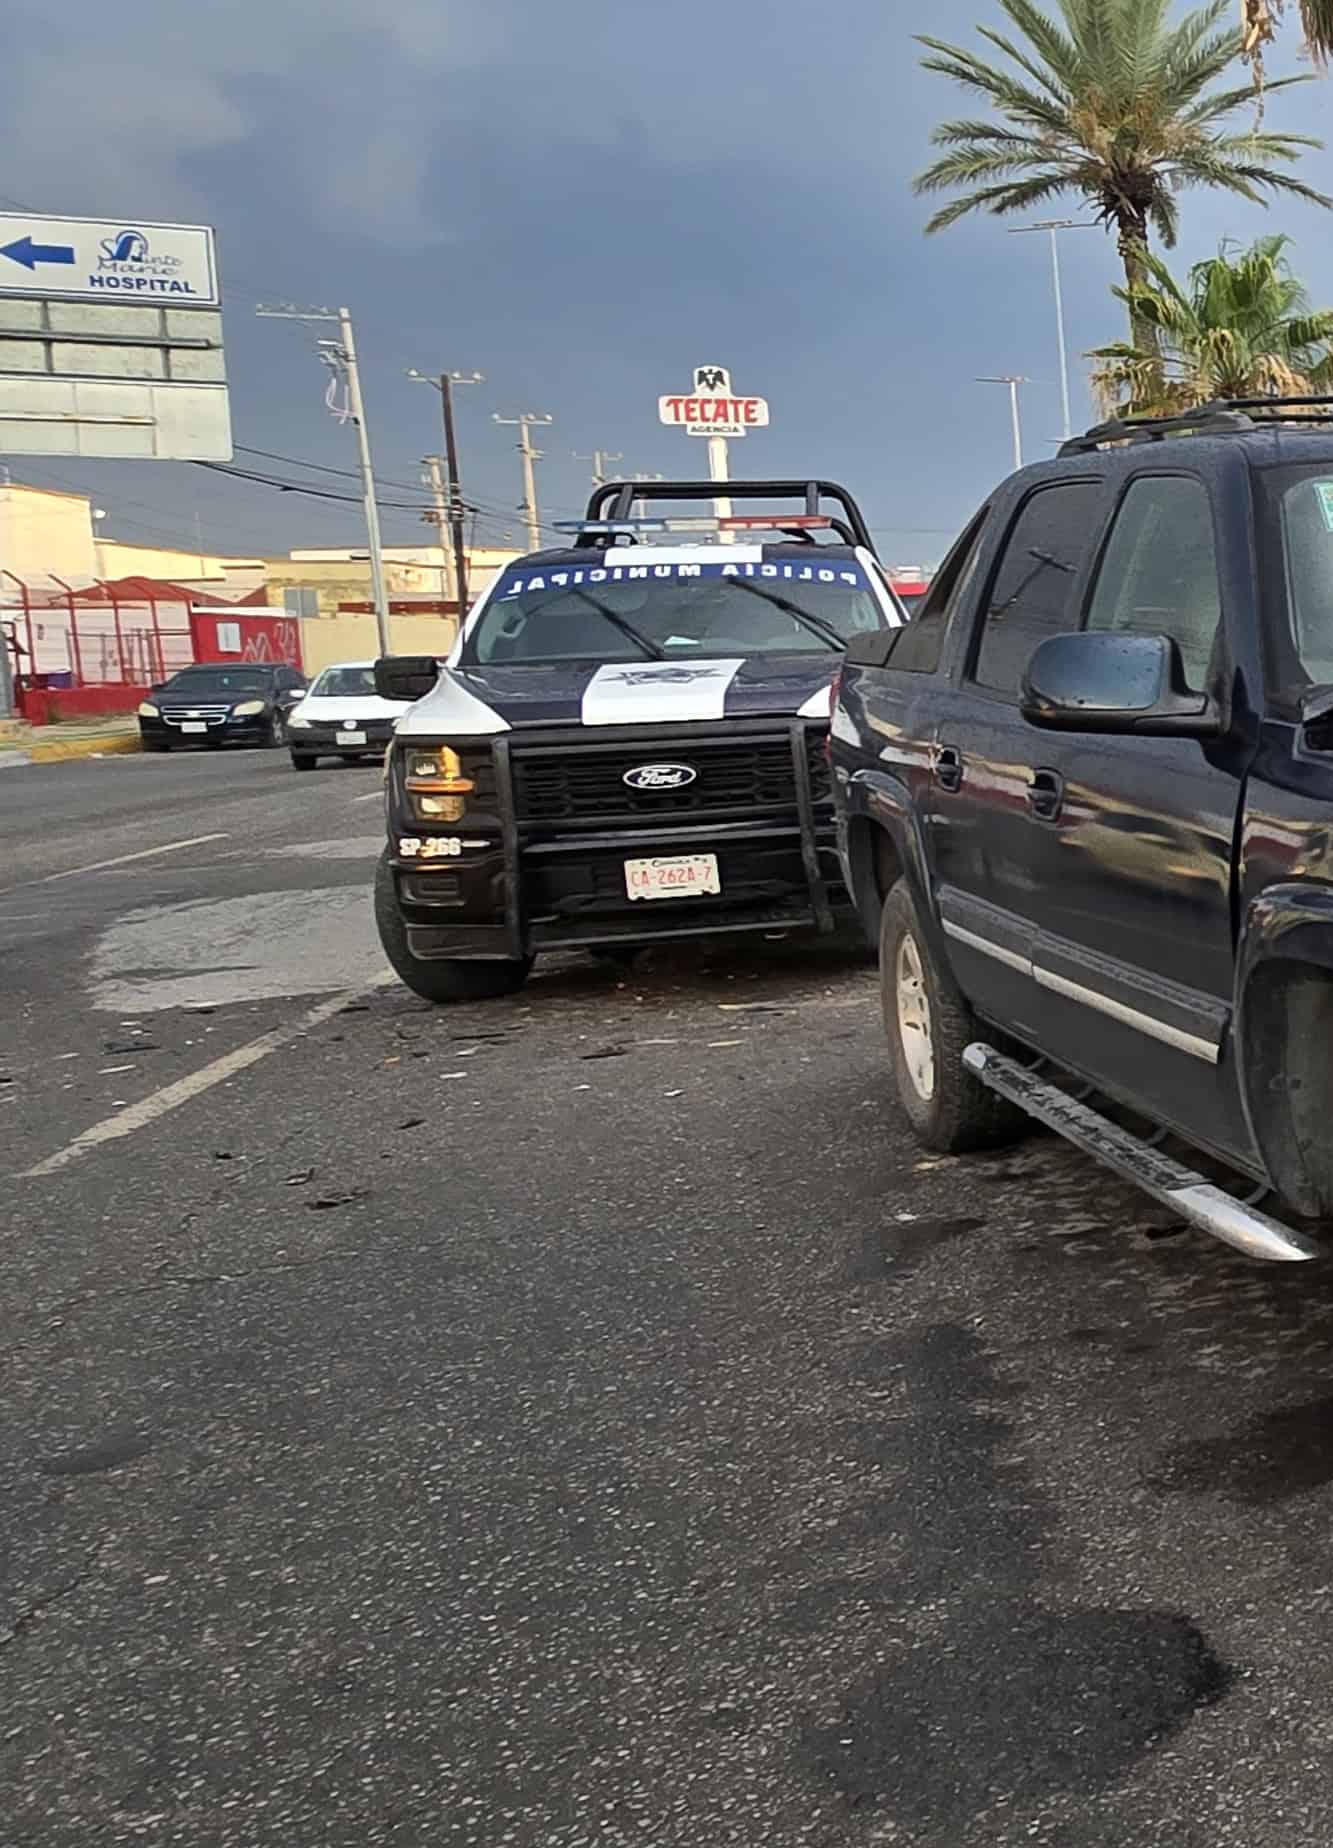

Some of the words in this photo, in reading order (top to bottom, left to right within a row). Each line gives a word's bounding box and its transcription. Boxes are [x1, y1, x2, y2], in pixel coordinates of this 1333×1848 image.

[89, 275, 197, 294] HOSPITAL
[666, 398, 759, 423] TECATE
[638, 768, 683, 786] Ford
[631, 866, 712, 888] CA-262A-7
